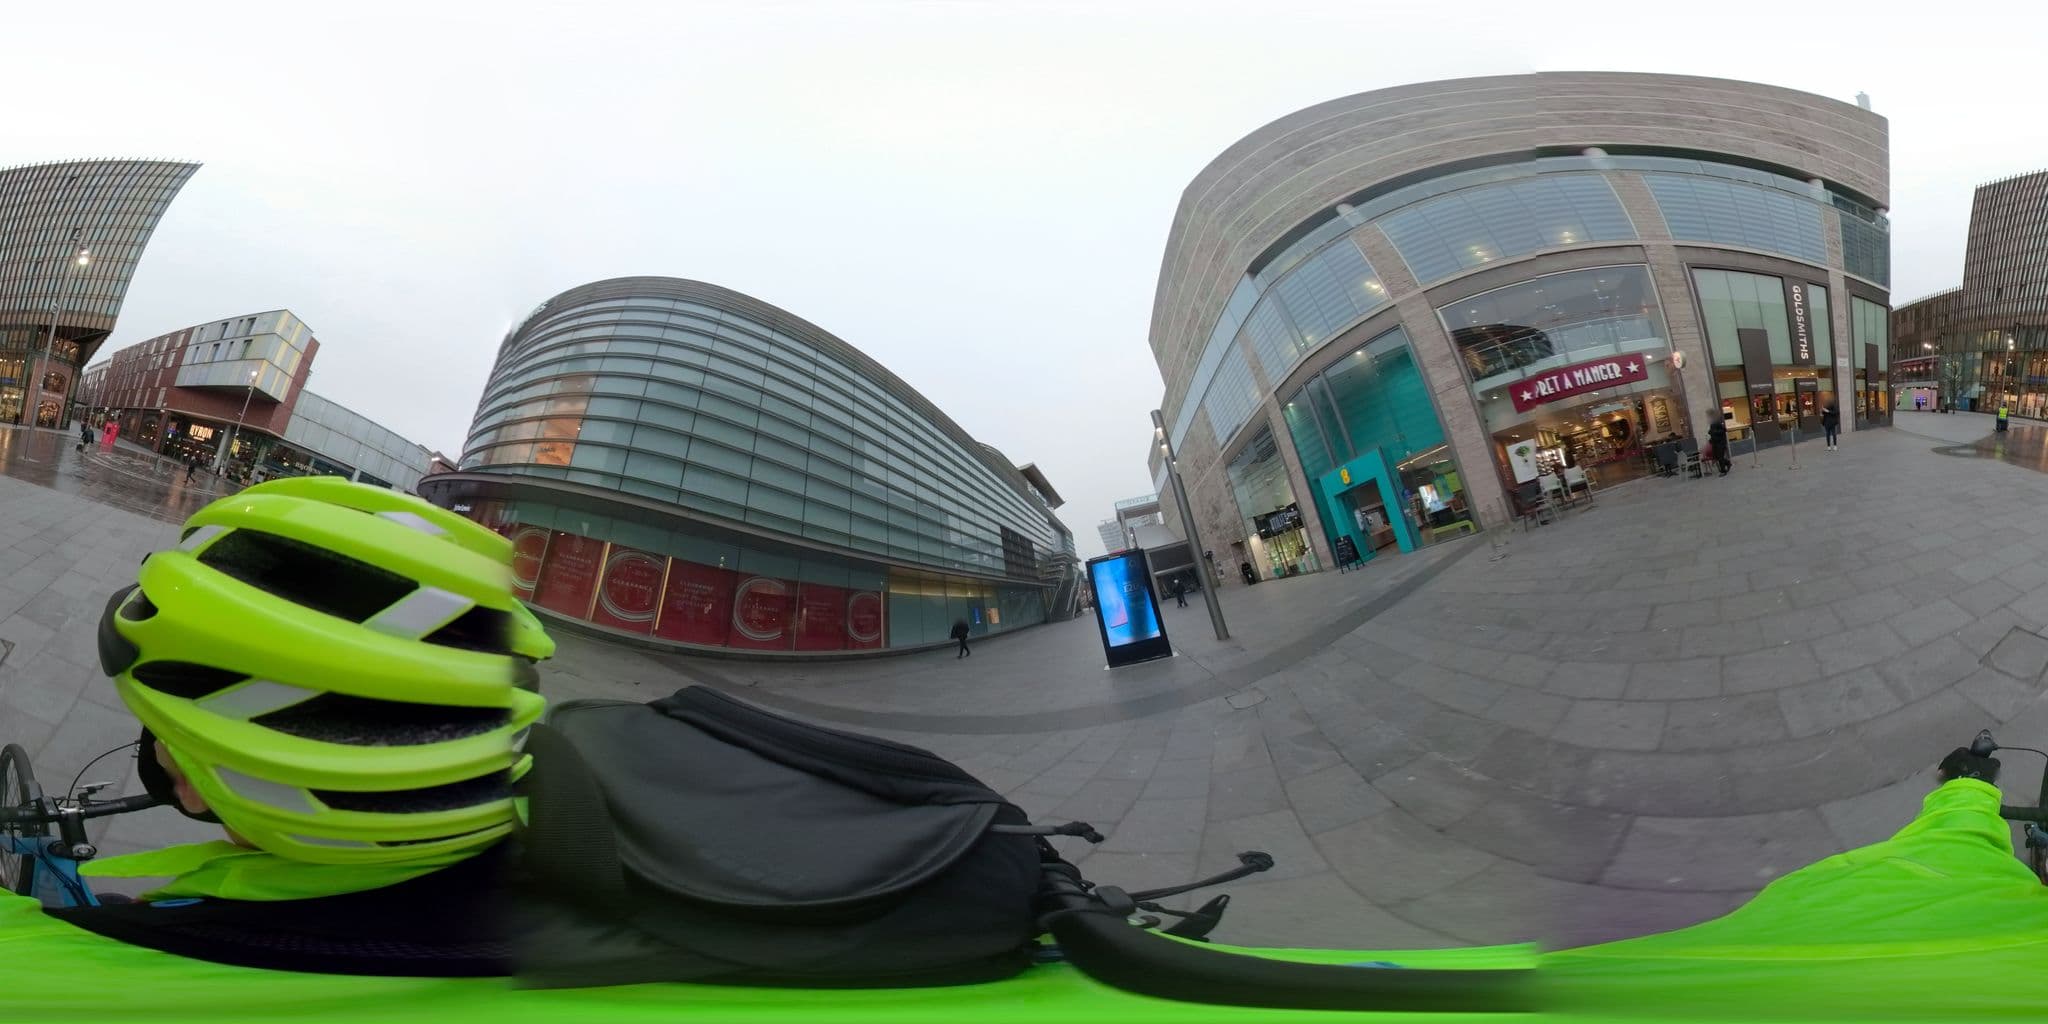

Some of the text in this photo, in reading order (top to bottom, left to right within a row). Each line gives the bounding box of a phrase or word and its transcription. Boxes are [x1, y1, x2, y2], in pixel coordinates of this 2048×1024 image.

[1792, 285, 1809, 360] GOLDSMITHS
[1563, 373, 1573, 390] A
[1572, 362, 1622, 387] MANGER
[189, 424, 214, 440] BYRON
